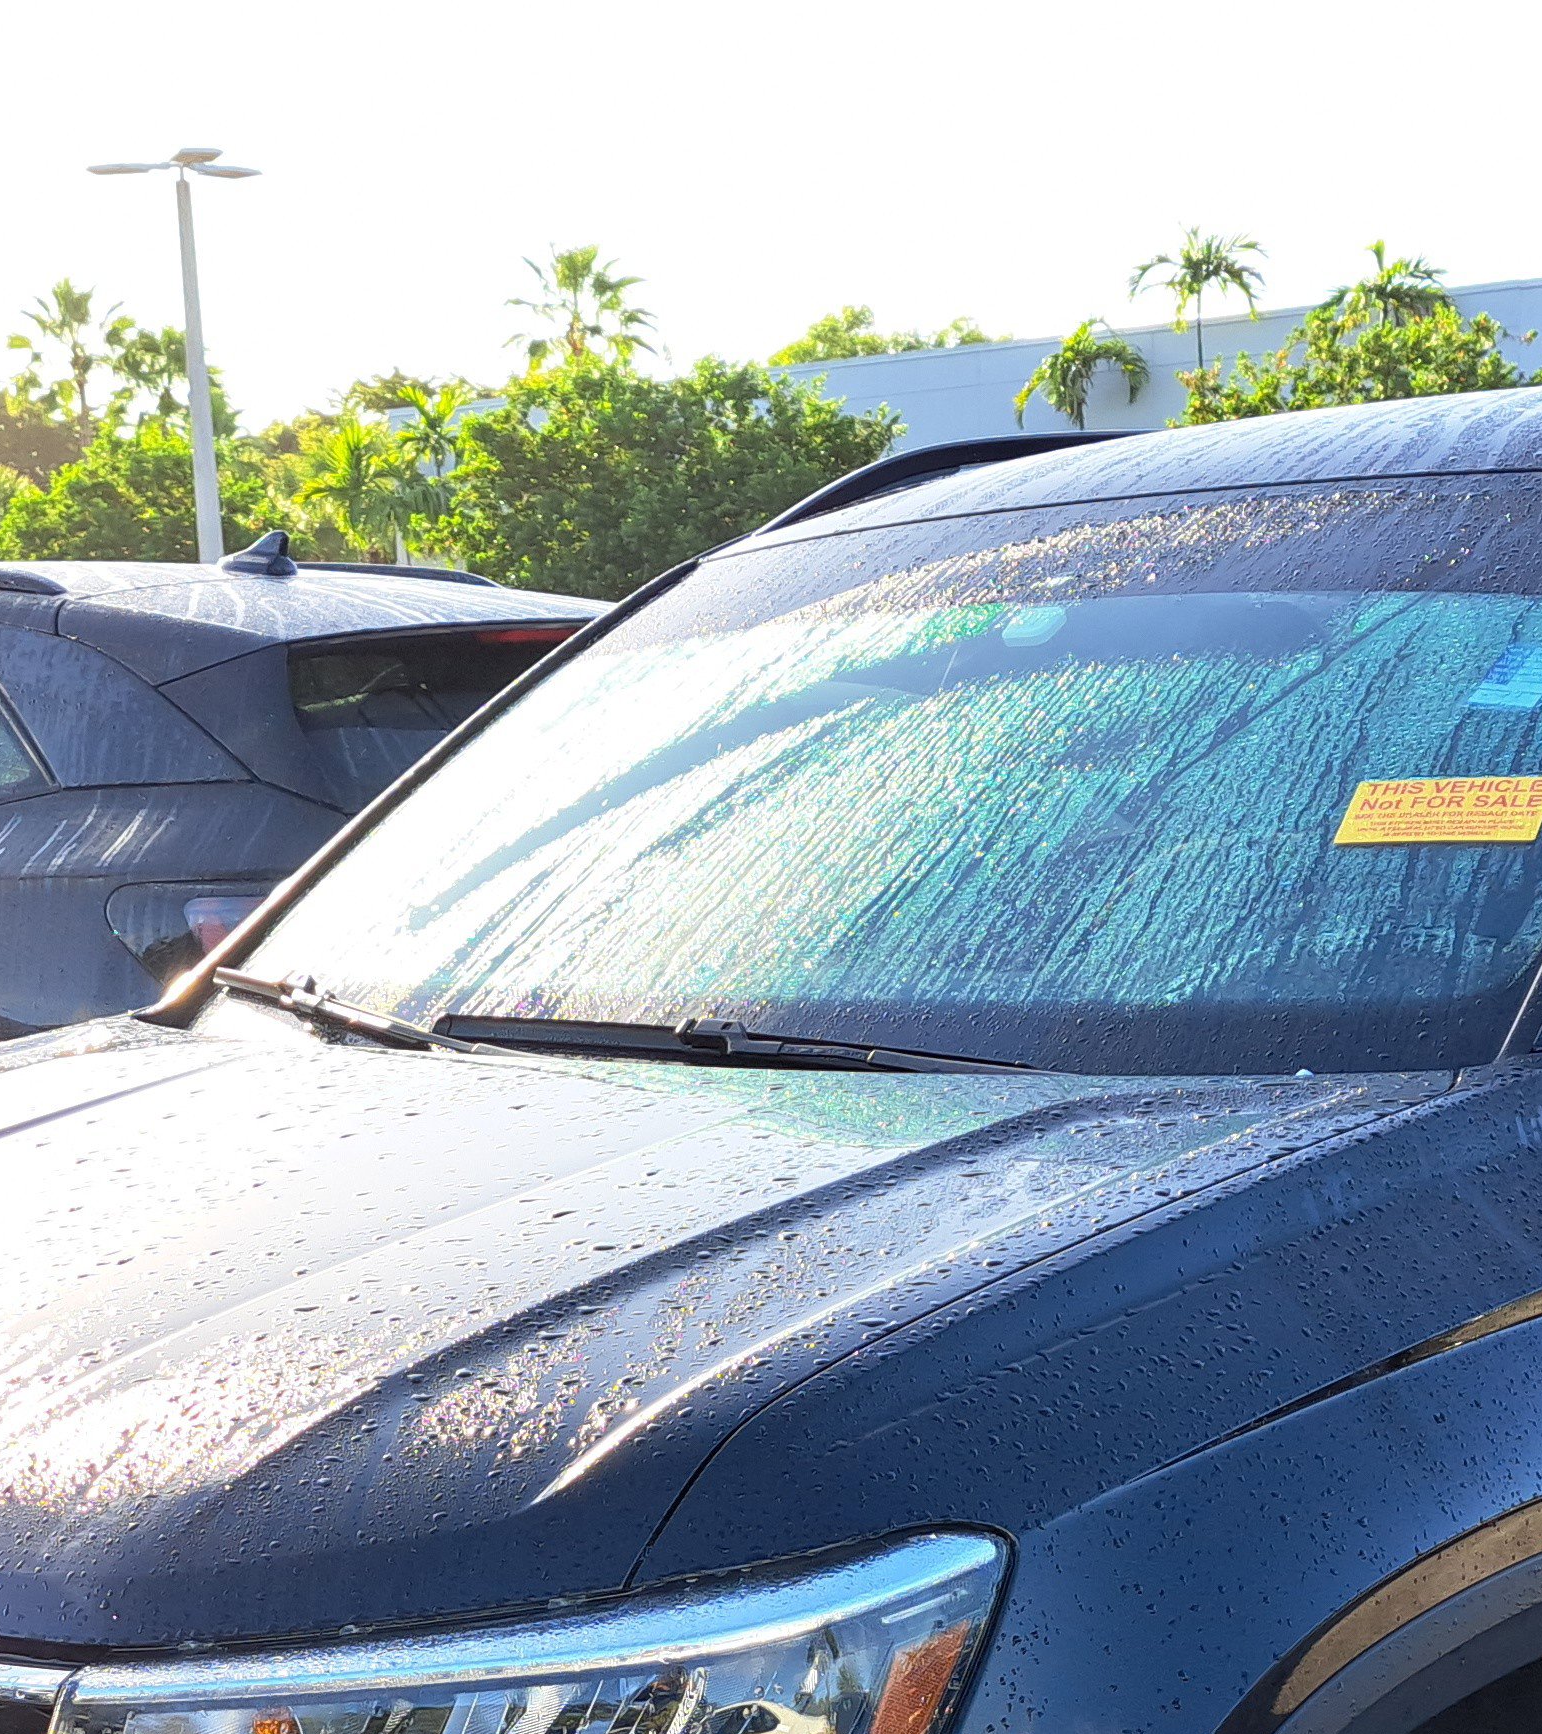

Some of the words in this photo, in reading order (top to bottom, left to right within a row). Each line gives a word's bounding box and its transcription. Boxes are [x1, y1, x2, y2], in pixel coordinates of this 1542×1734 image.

[1368, 782, 1424, 796] THIS
[1359, 798, 1402, 811] Not
[1410, 795, 1463, 809] FOR
